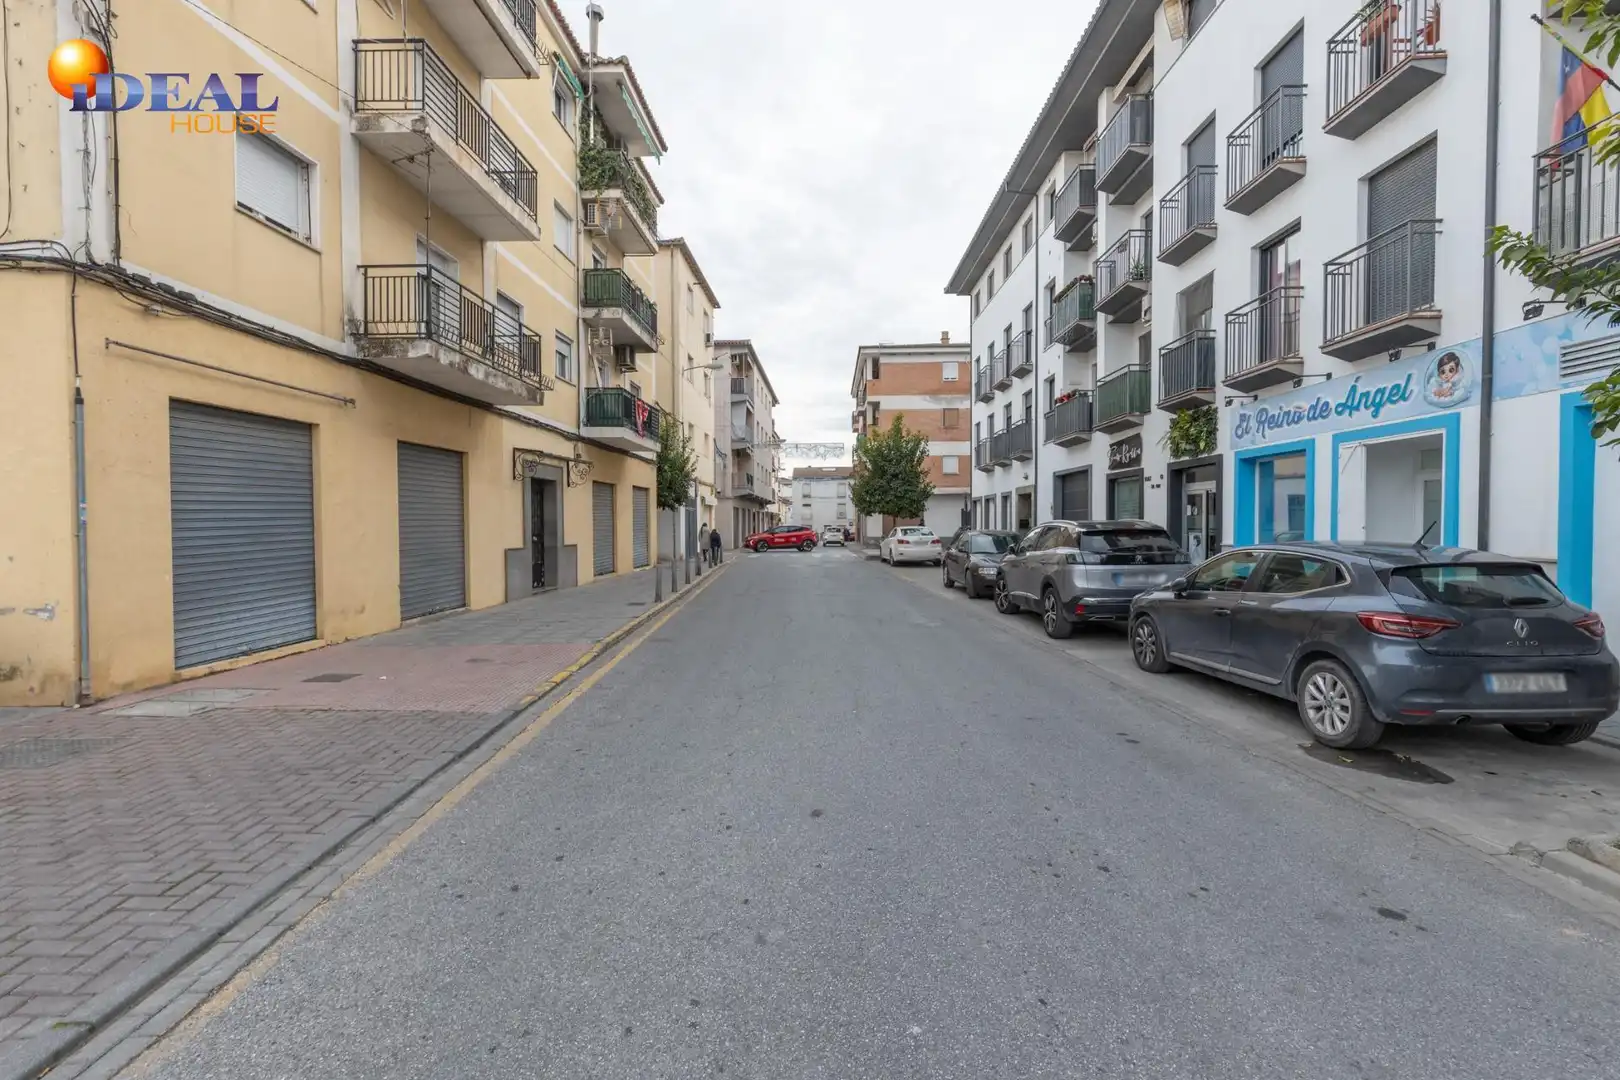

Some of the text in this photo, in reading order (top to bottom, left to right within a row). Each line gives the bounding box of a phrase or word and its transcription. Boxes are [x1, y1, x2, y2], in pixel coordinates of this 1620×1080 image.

[1234, 373, 1413, 439] El Reino de Ángel
